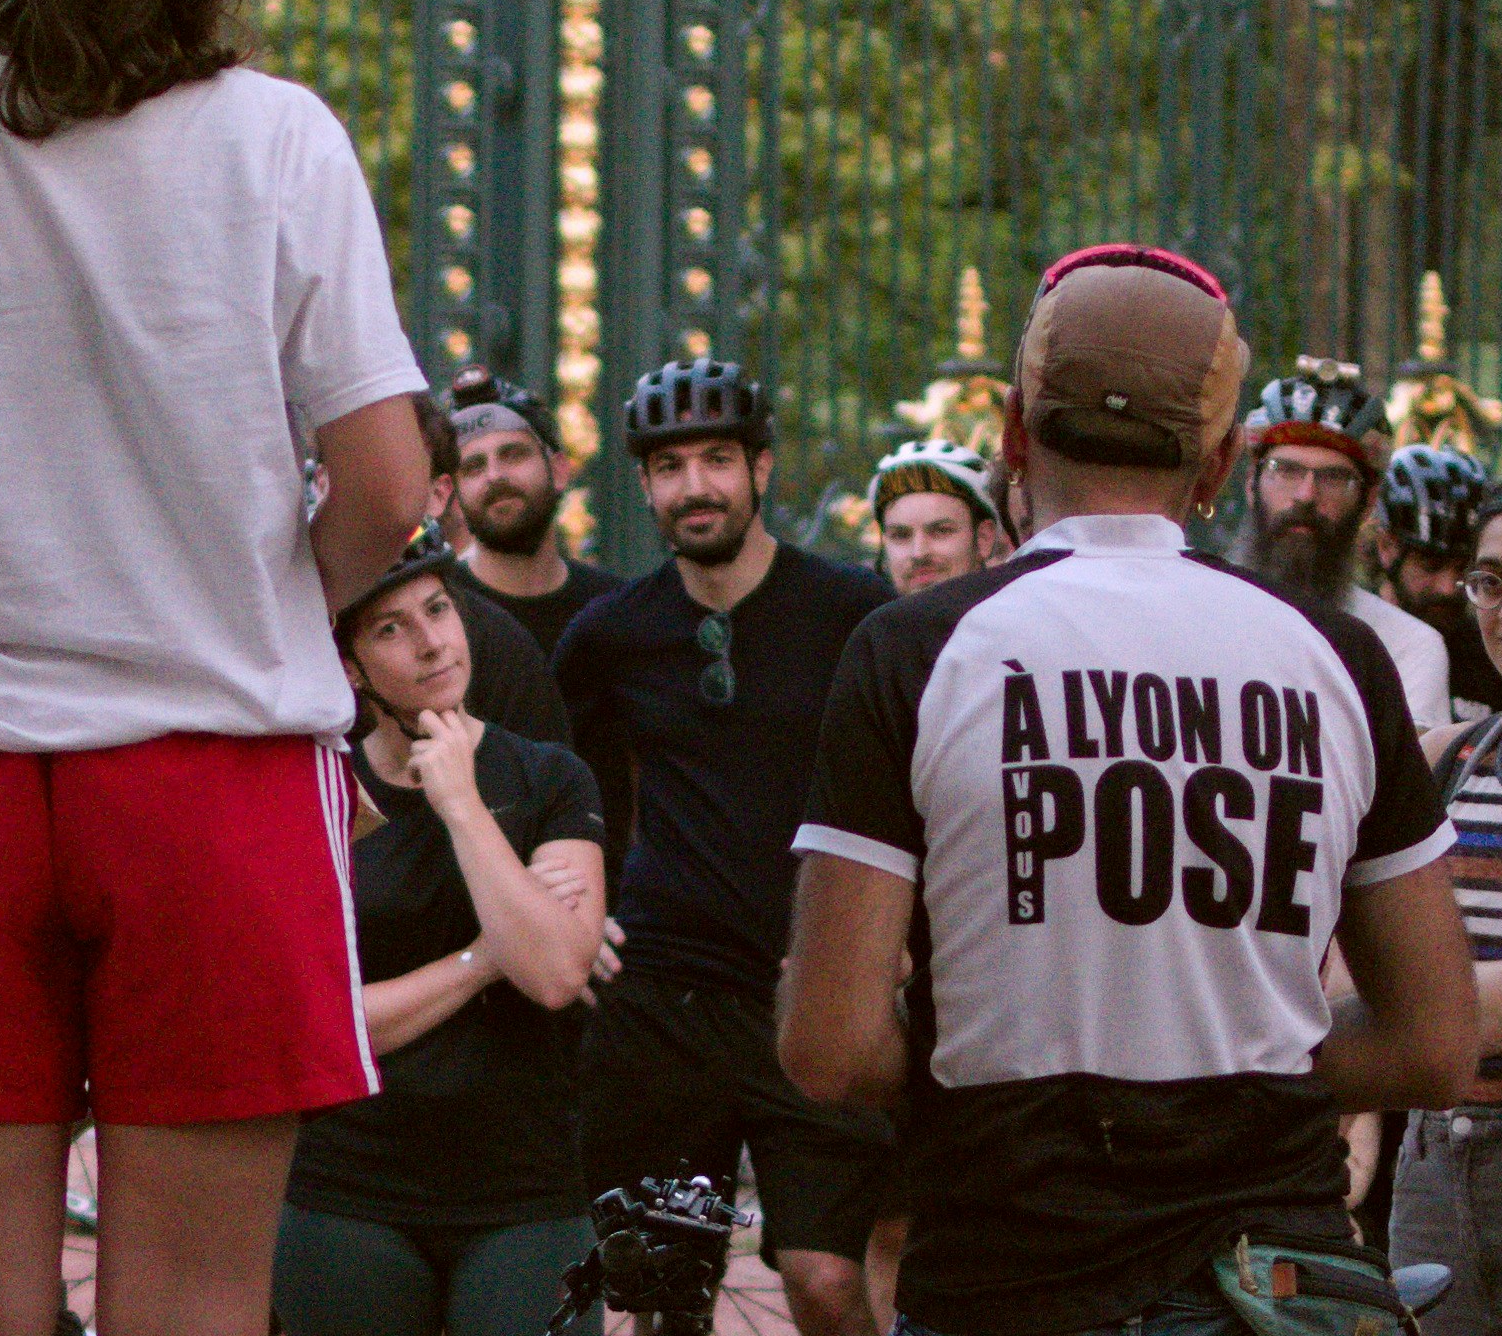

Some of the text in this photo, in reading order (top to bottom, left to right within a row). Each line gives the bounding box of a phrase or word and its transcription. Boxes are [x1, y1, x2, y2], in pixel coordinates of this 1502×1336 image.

[1001, 658, 1324, 779] À LYON ON
[1001, 759, 1324, 937] POSE
[1010, 770, 1036, 920] VOUS
